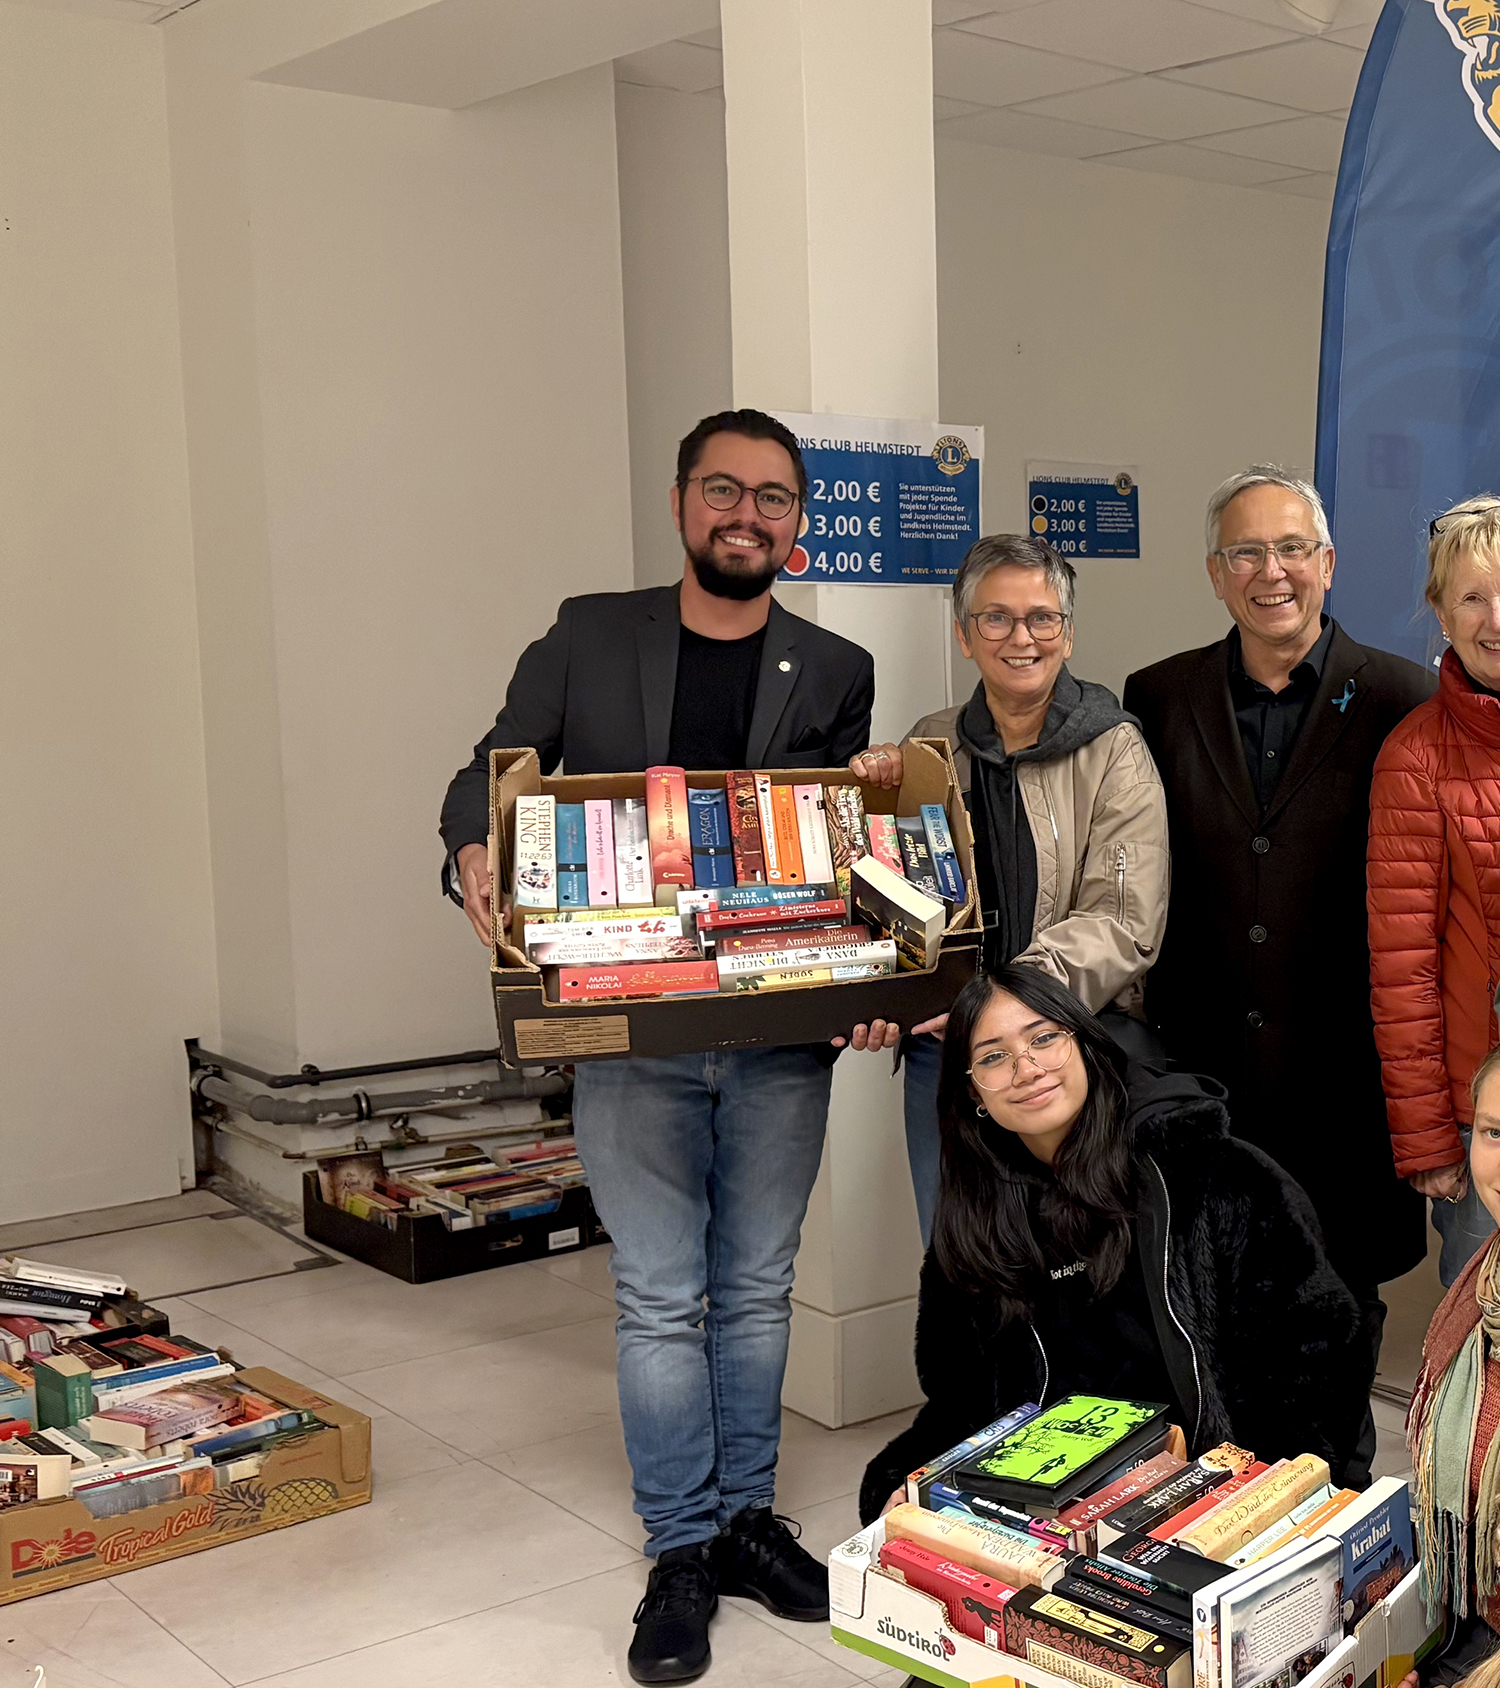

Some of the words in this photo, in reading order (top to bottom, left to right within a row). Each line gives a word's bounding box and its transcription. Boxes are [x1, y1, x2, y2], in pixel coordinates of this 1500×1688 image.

[795, 438, 816, 449] ONS
[820, 439, 851, 451] CLUB
[855, 441, 921, 456] HELMSTEDT
[947, 448, 958, 463] L
[813, 479, 861, 503] 2,00
[867, 482, 881, 503] €
[899, 483, 909, 491] Sie
[910, 484, 956, 493] unterstützen
[899, 493, 910, 501] mit
[911, 494, 929, 502] jeder
[930, 494, 958, 503] Spende
[1050, 499, 1075, 513] 2,00
[1078, 500, 1086, 513] €
[899, 502, 927, 511] Projekte
[928, 503, 939, 511] für
[940, 504, 965, 512] Kinder
[814, 514, 862, 538] 3,00
[868, 516, 882, 537] €
[900, 522, 931, 530] Landkreis
[913, 513, 955, 522] Jugendliche
[1050, 519, 1076, 533] 3,00
[1078, 519, 1087, 532] €
[900, 531, 935, 540] Herzlichen
[936, 532, 958, 540] Dank!
[1051, 540, 1076, 554] 4,00
[1079, 540, 1087, 553] €
[815, 551, 862, 575] 4,00
[868, 552, 883, 573] €
[927, 806, 940, 821] FEAR
[520, 806, 537, 844] KING
[538, 800, 552, 852] STEPHEN
[700, 807, 714, 846] ERAGON
[933, 829, 948, 848] WORST
[722, 897, 770, 907] NEUHAUS
[797, 889, 817, 899] WOLF
[604, 925, 633, 934] KIND
[827, 929, 843, 937] Die
[785, 931, 858, 947] Amerikanerin
[826, 949, 858, 960] DANA
[729, 959, 766, 970] NICHT
[586, 982, 622, 990] NIKOLAI
[1080, 1404, 1120, 1425] 13
[1173, 1470, 1210, 1493] SARAH
[1081, 1497, 1118, 1520] SARAH
[1115, 1483, 1141, 1503] LARK
[1147, 1489, 1174, 1509] LARK
[1231, 1497, 1263, 1527] Wind
[1272, 1461, 1315, 1493] Erinnerung
[11, 1528, 96, 1572] Dole
[100, 1518, 171, 1565] Tropical
[171, 1500, 214, 1537] Gold
[981, 1531, 1037, 1557] WALDEN
[1247, 1533, 1274, 1556] HARPER
[1273, 1525, 1288, 1540] LEE
[1351, 1514, 1392, 1562] Krabat
[981, 1539, 1026, 1564] LAURA
[1083, 1564, 1112, 1581] Brooks
[1085, 1557, 1117, 1576] Allahs
[1111, 1576, 1153, 1597] Geraldine
[1116, 1569, 1147, 1588] Töchter
[1146, 1582, 1159, 1591] Die
